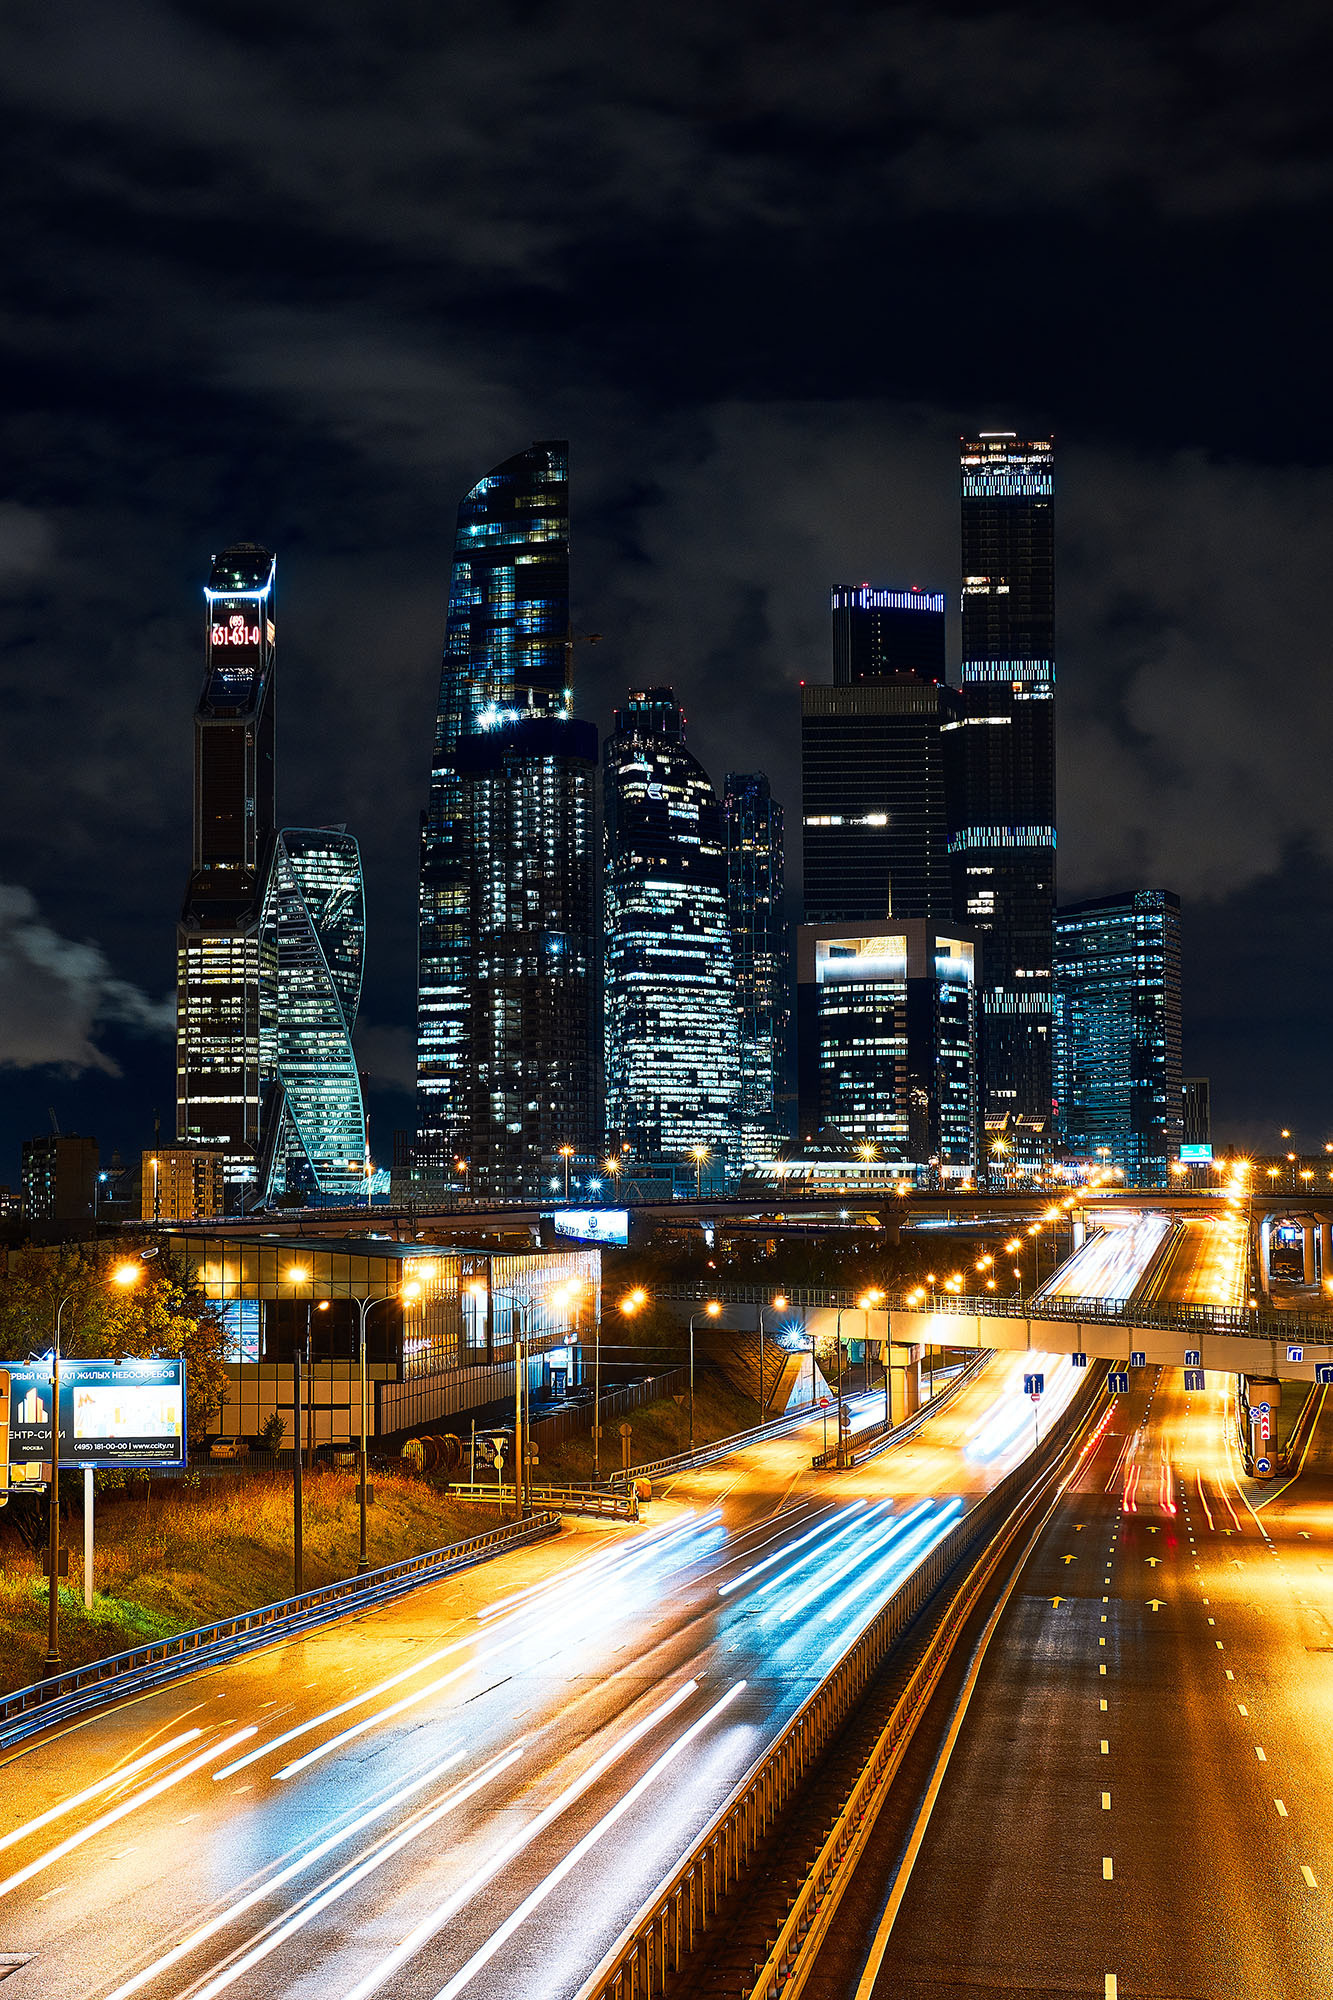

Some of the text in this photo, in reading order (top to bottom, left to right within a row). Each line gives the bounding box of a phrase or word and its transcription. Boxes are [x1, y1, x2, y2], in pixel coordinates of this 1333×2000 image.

[212, 626, 259, 645] 651-651-0
[10, 1370, 175, 1381] РВЫЙ КВАТАЛ ЖИЛЫХ НЕБОСКРЕБОВ
[9, 1430, 66, 1440] ЕНТР-СИИ
[74, 1443, 93, 1451] (495)
[132, 1442, 175, 1450] www.ccity.ru
